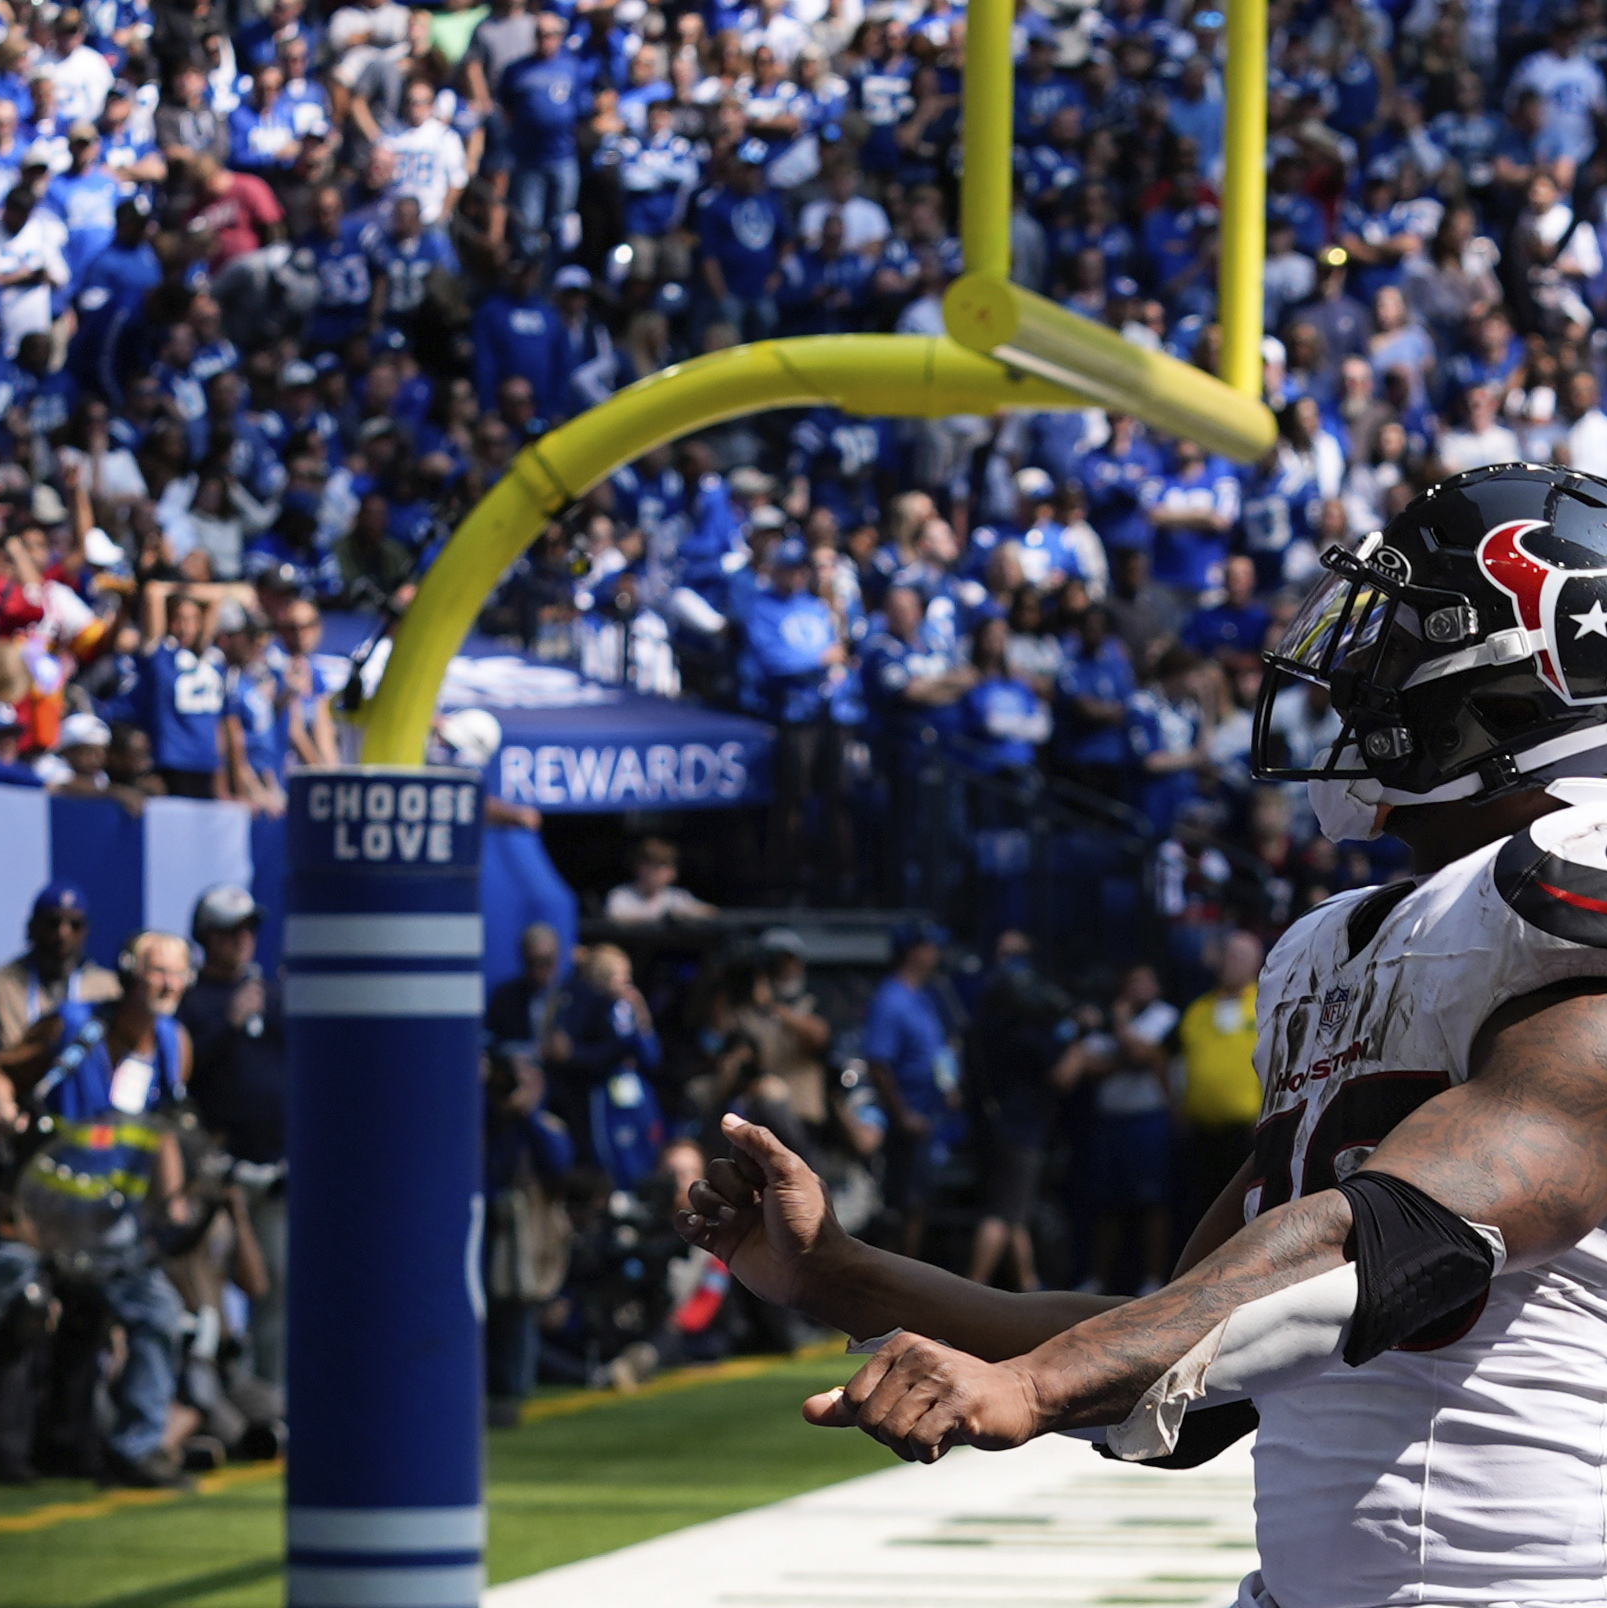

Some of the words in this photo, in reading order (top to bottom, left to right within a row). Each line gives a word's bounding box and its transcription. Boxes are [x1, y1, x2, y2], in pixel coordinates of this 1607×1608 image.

[500, 741, 747, 804] REWARDS
[307, 784, 477, 825] CHOOSE
[334, 823, 452, 860] LOVE
